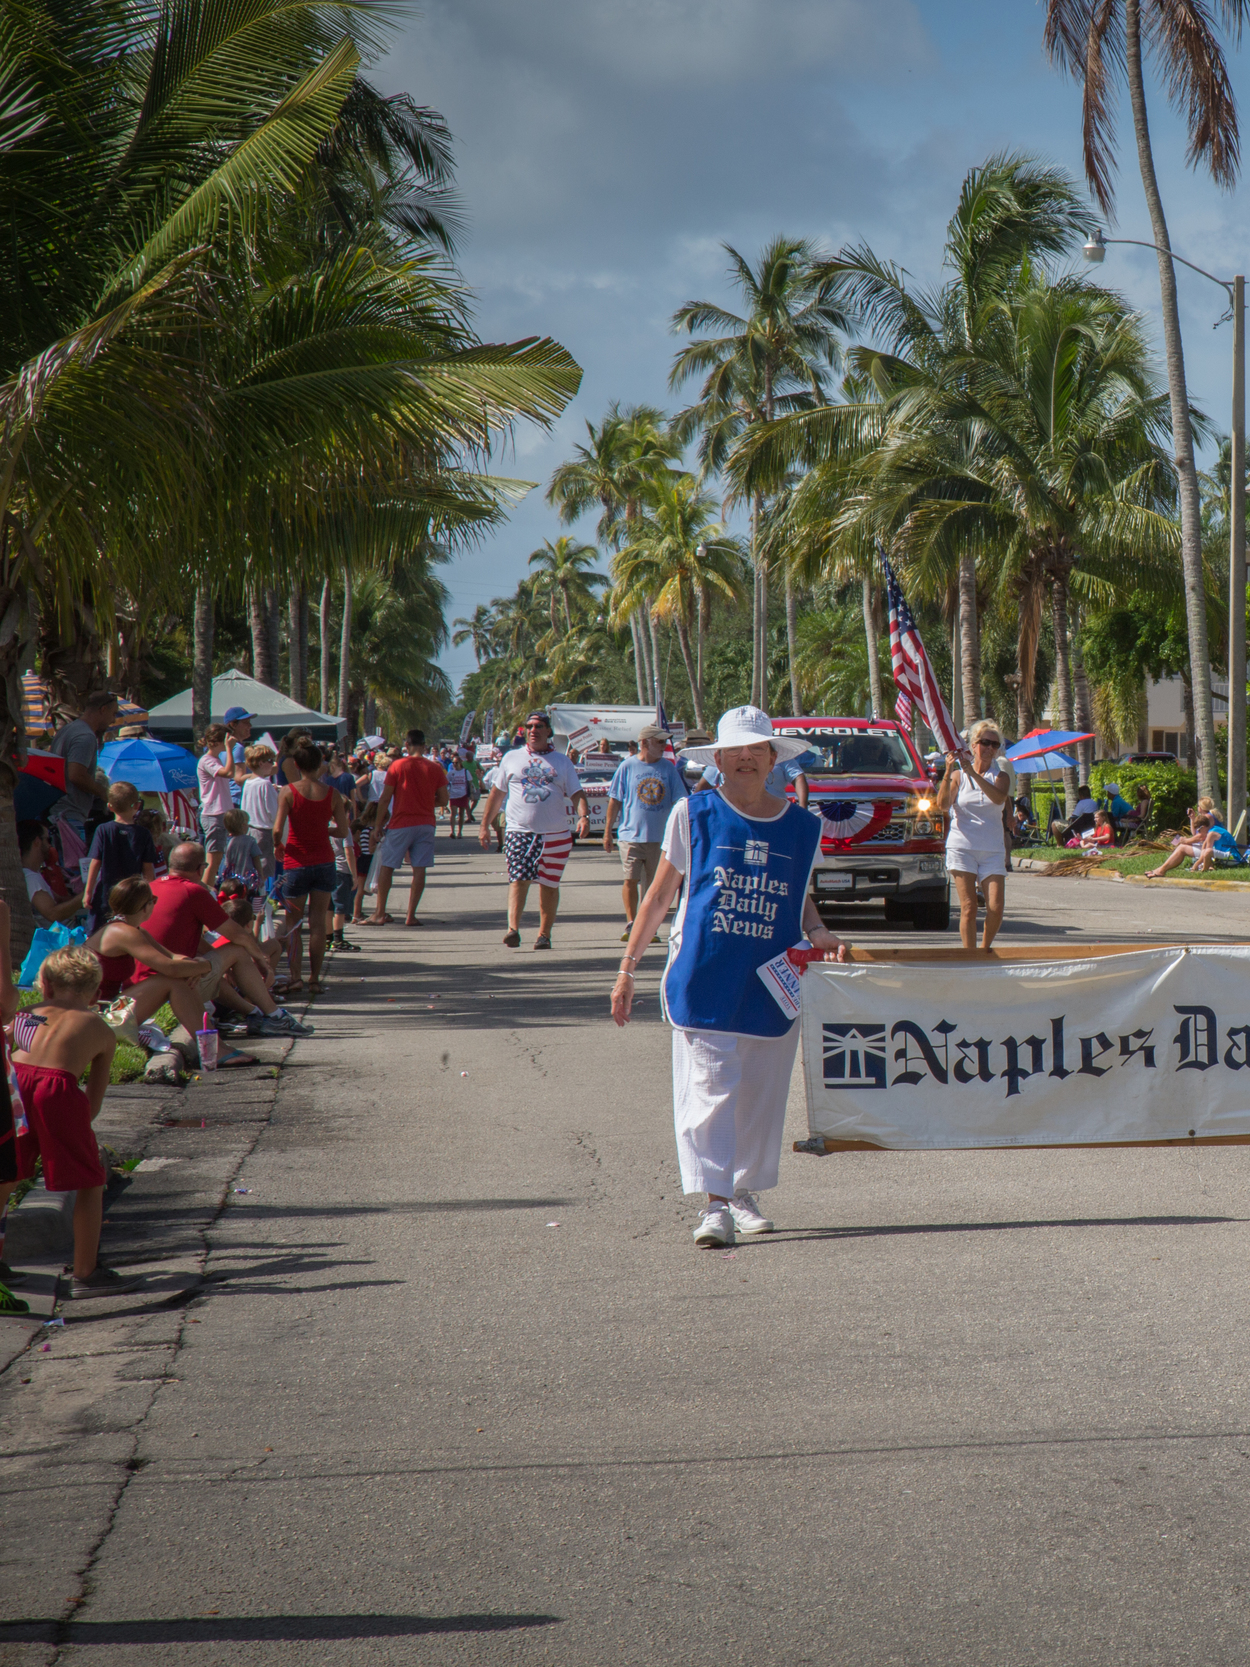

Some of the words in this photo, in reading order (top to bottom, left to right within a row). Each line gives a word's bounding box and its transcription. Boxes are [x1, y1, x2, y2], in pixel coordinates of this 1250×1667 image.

[772, 727, 897, 737] HEVROLET
[713, 866, 788, 896] Naples
[718, 888, 778, 922] Daily
[711, 911, 774, 939] News
[891, 1014, 1156, 1098] Naples
